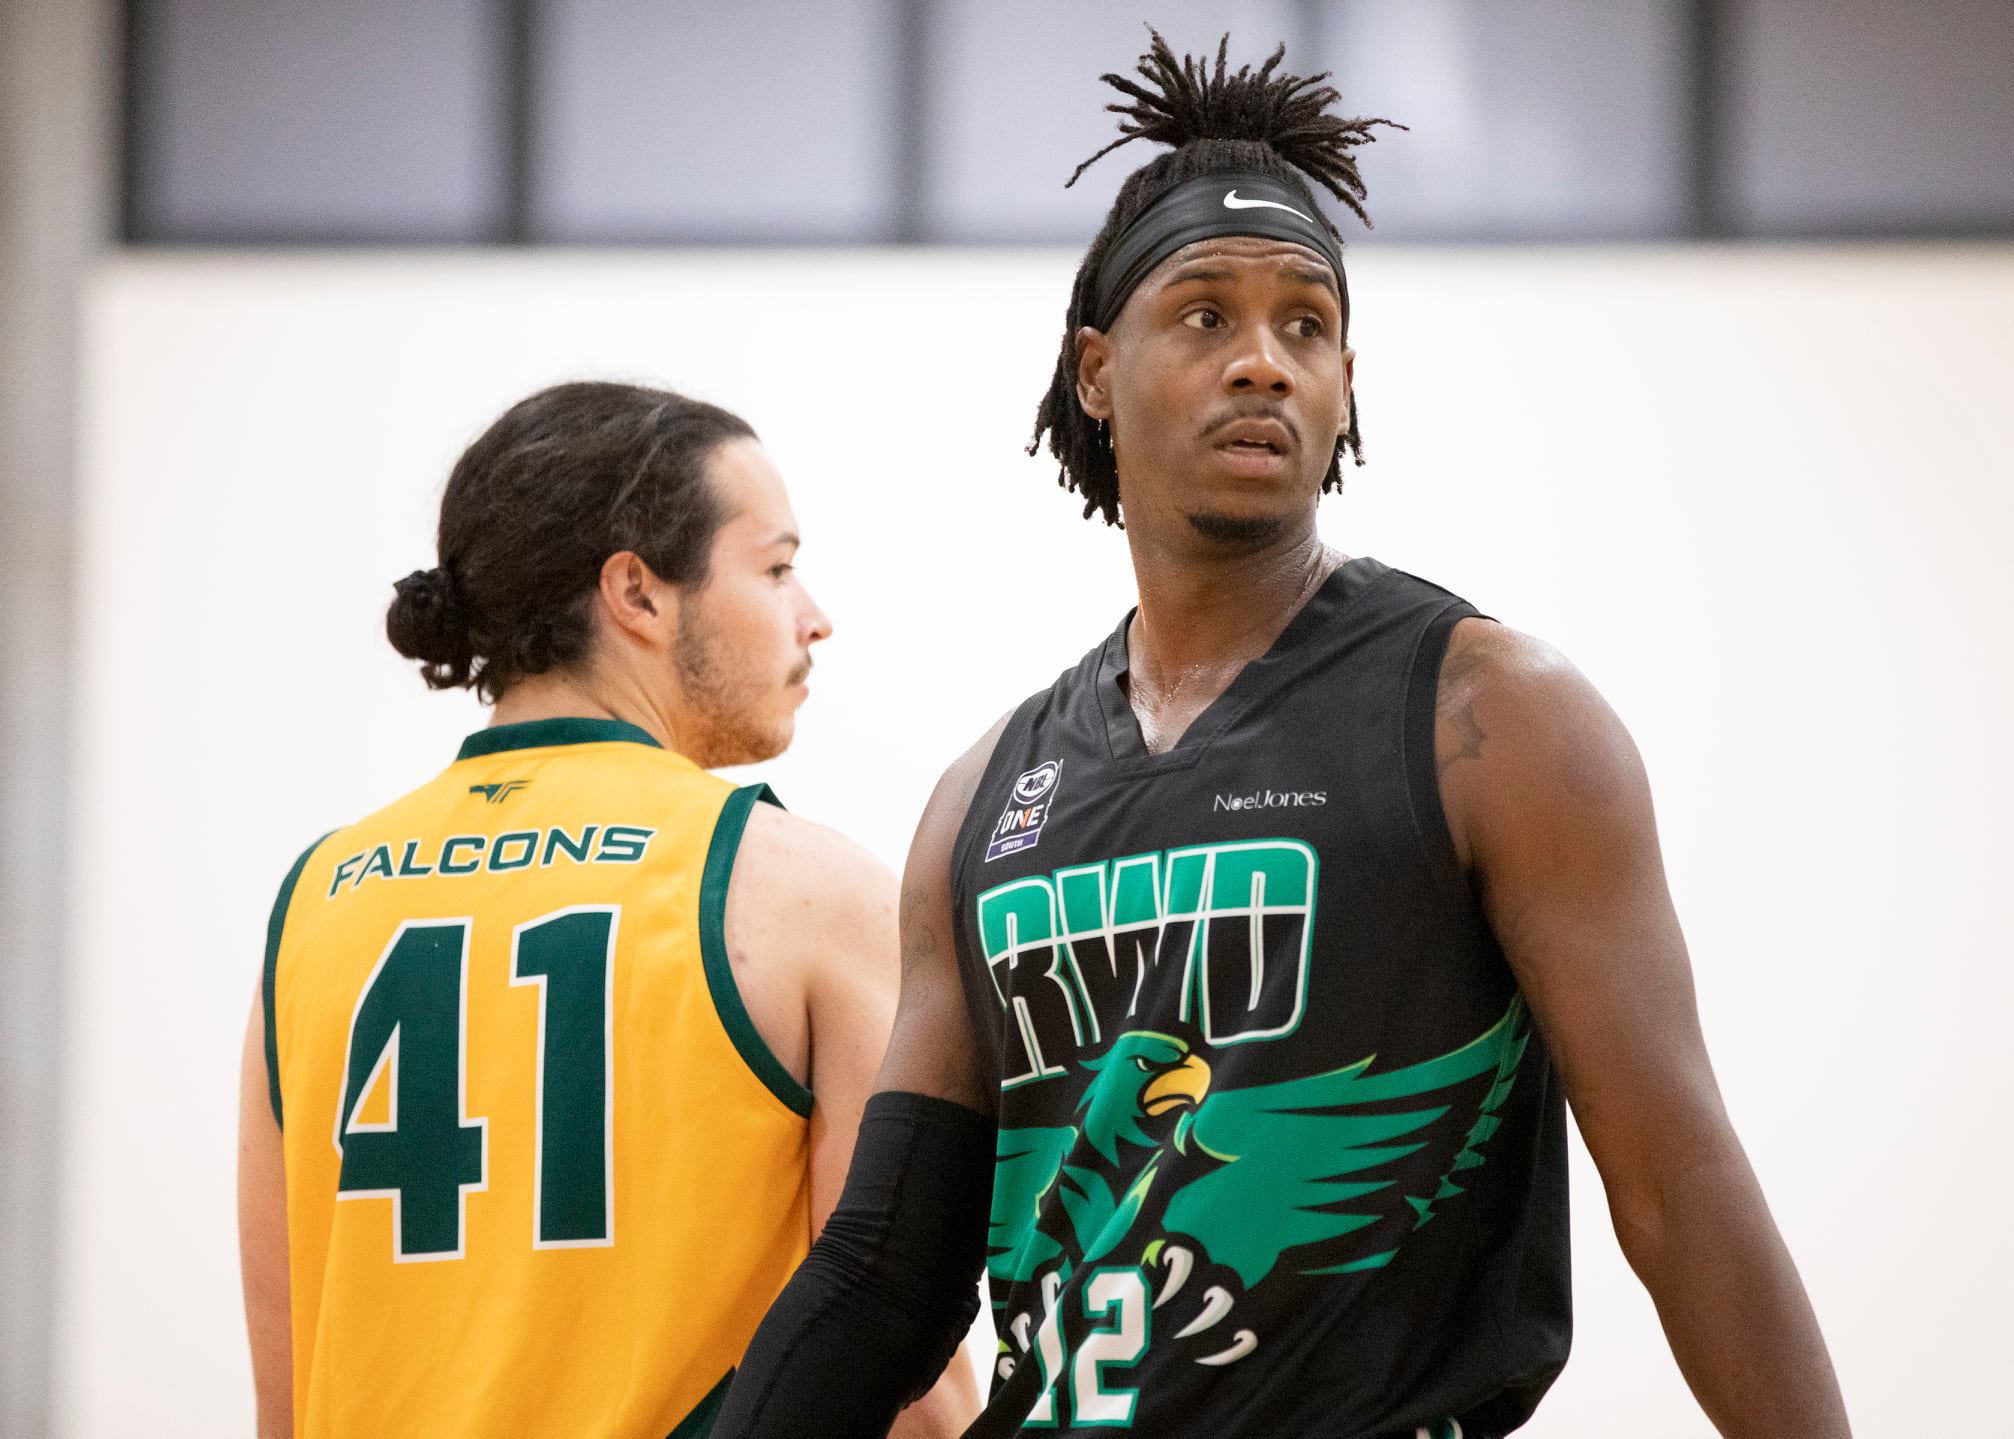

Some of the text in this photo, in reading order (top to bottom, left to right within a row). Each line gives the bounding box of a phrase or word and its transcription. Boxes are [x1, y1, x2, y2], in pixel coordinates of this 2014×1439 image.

[1000, 804, 1045, 835] ONE
[1213, 789, 1327, 812] NoelJones
[326, 823, 657, 901] FALCONS
[1000, 839, 1024, 852] SOUTH
[977, 838, 1320, 1092] RWD
[332, 904, 622, 1264] 41
